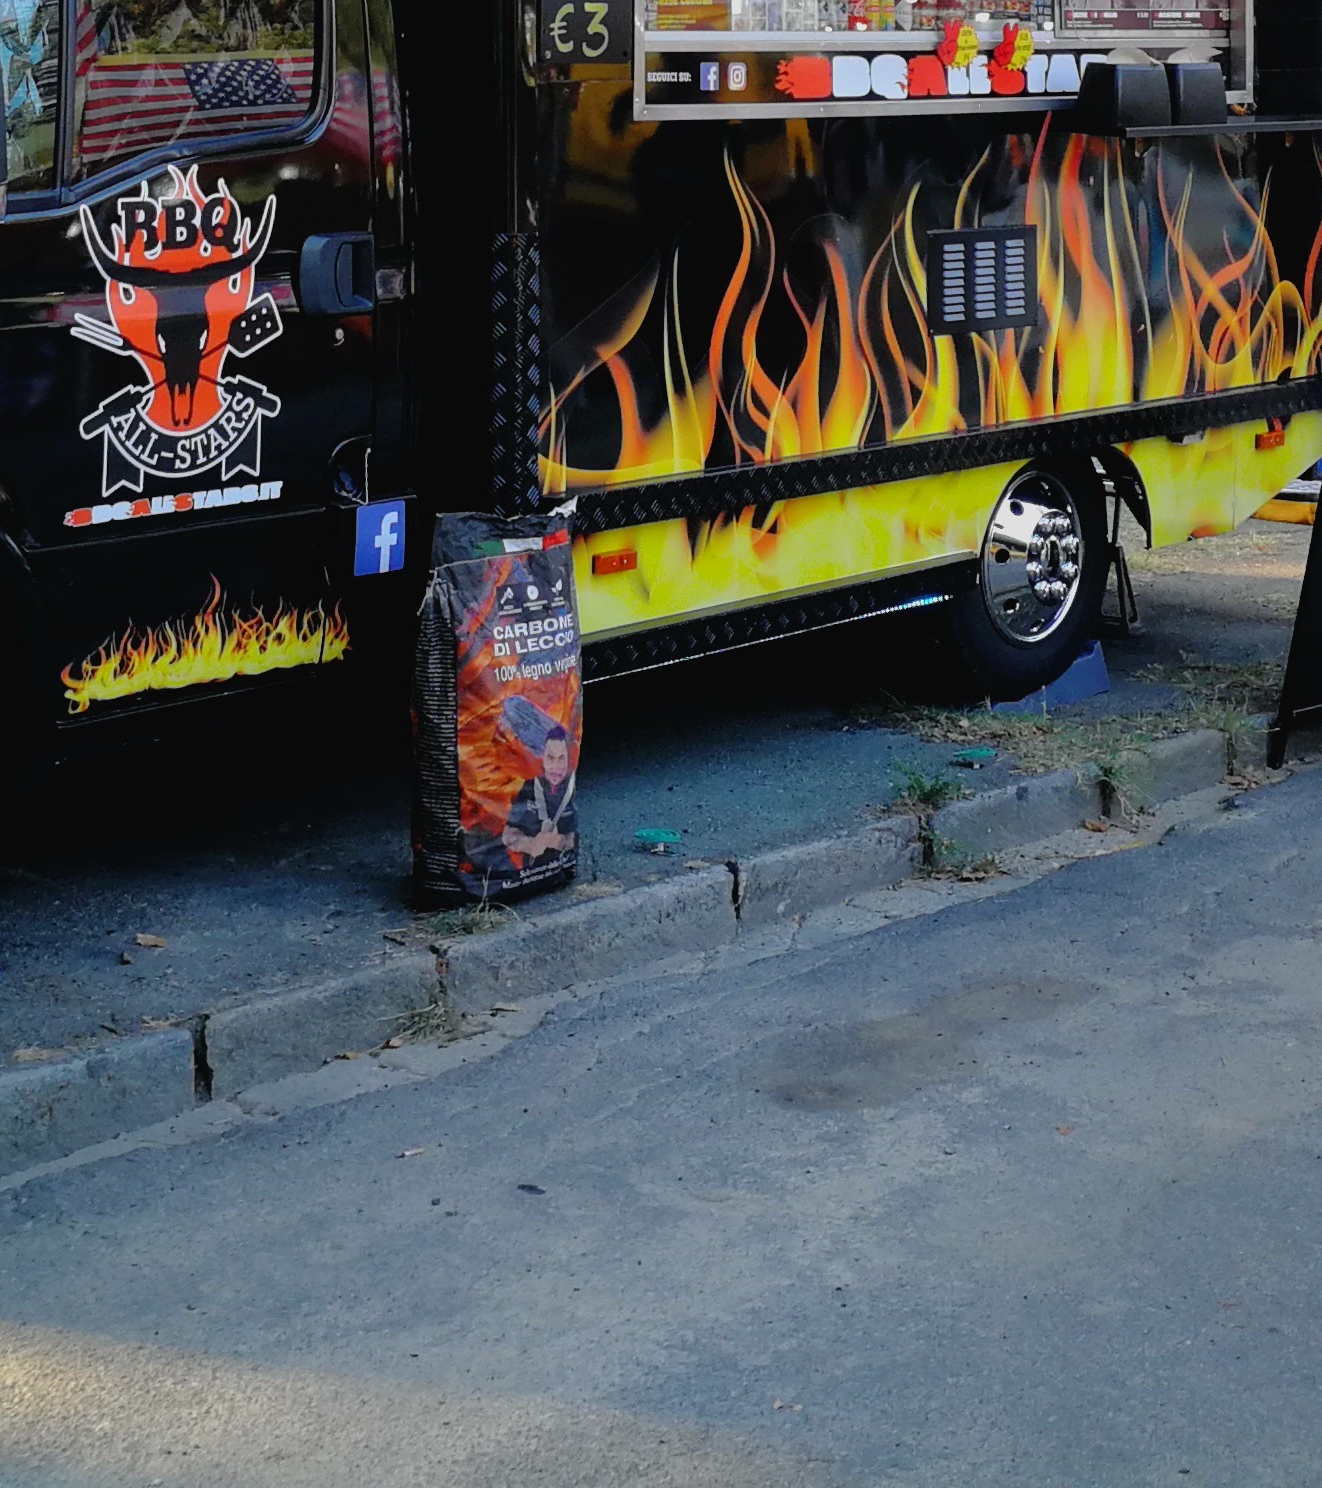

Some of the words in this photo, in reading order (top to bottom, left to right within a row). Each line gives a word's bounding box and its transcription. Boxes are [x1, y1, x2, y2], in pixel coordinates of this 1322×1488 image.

[646, 72, 678, 83] SEGUICI
[110, 390, 256, 471] ALL-STARS
[493, 613, 574, 640] CARBONE
[493, 641, 511, 657] DI
[515, 629, 574, 654] LECCIO
[521, 661, 552, 680] legno
